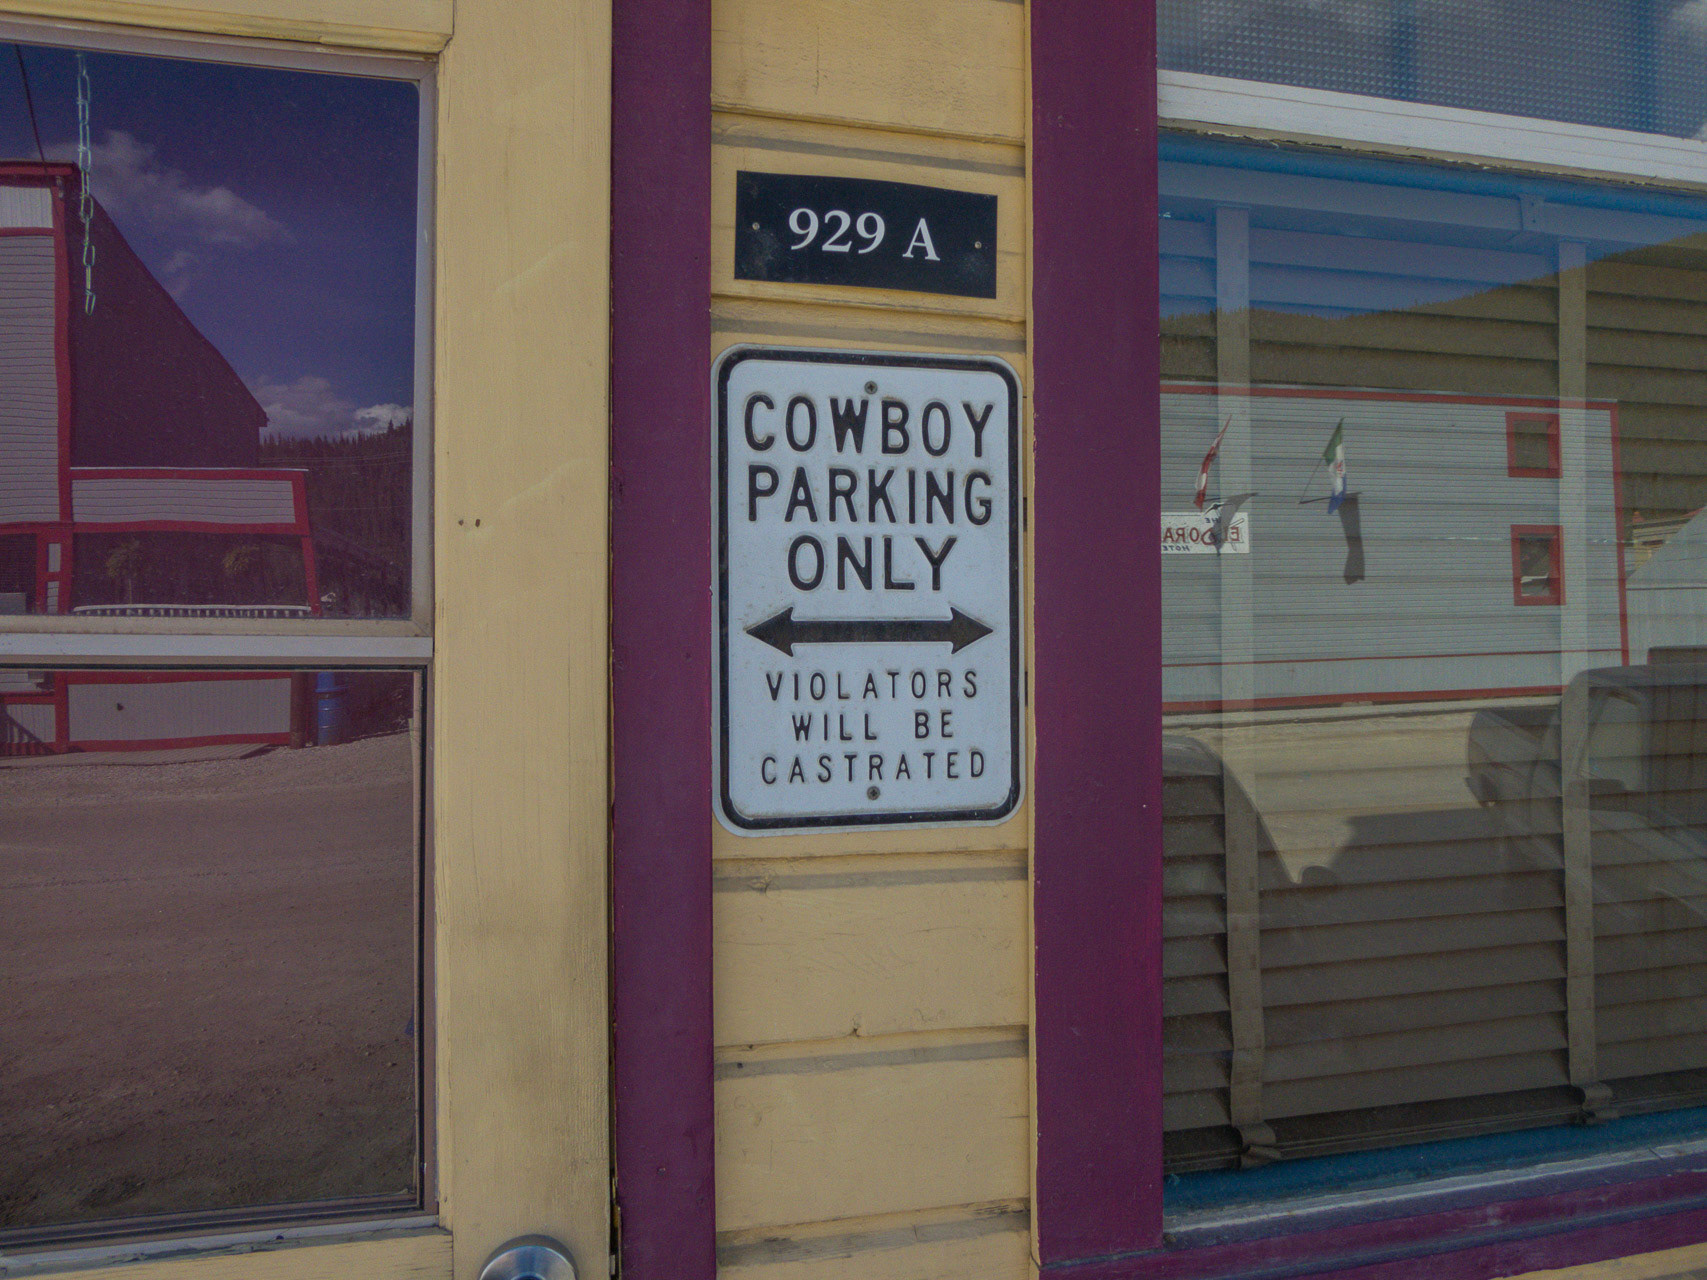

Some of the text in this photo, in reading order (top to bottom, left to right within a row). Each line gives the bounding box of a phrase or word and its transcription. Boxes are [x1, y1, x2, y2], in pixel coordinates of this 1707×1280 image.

[788, 207, 941, 262] 929 A
[744, 394, 994, 458] COWBOY
[748, 464, 992, 526] PARKING
[787, 534, 958, 592] ONLY
[765, 670, 978, 702] VIOLATORS
[791, 709, 954, 742] WILL BE
[760, 749, 985, 785] CASTRATED
